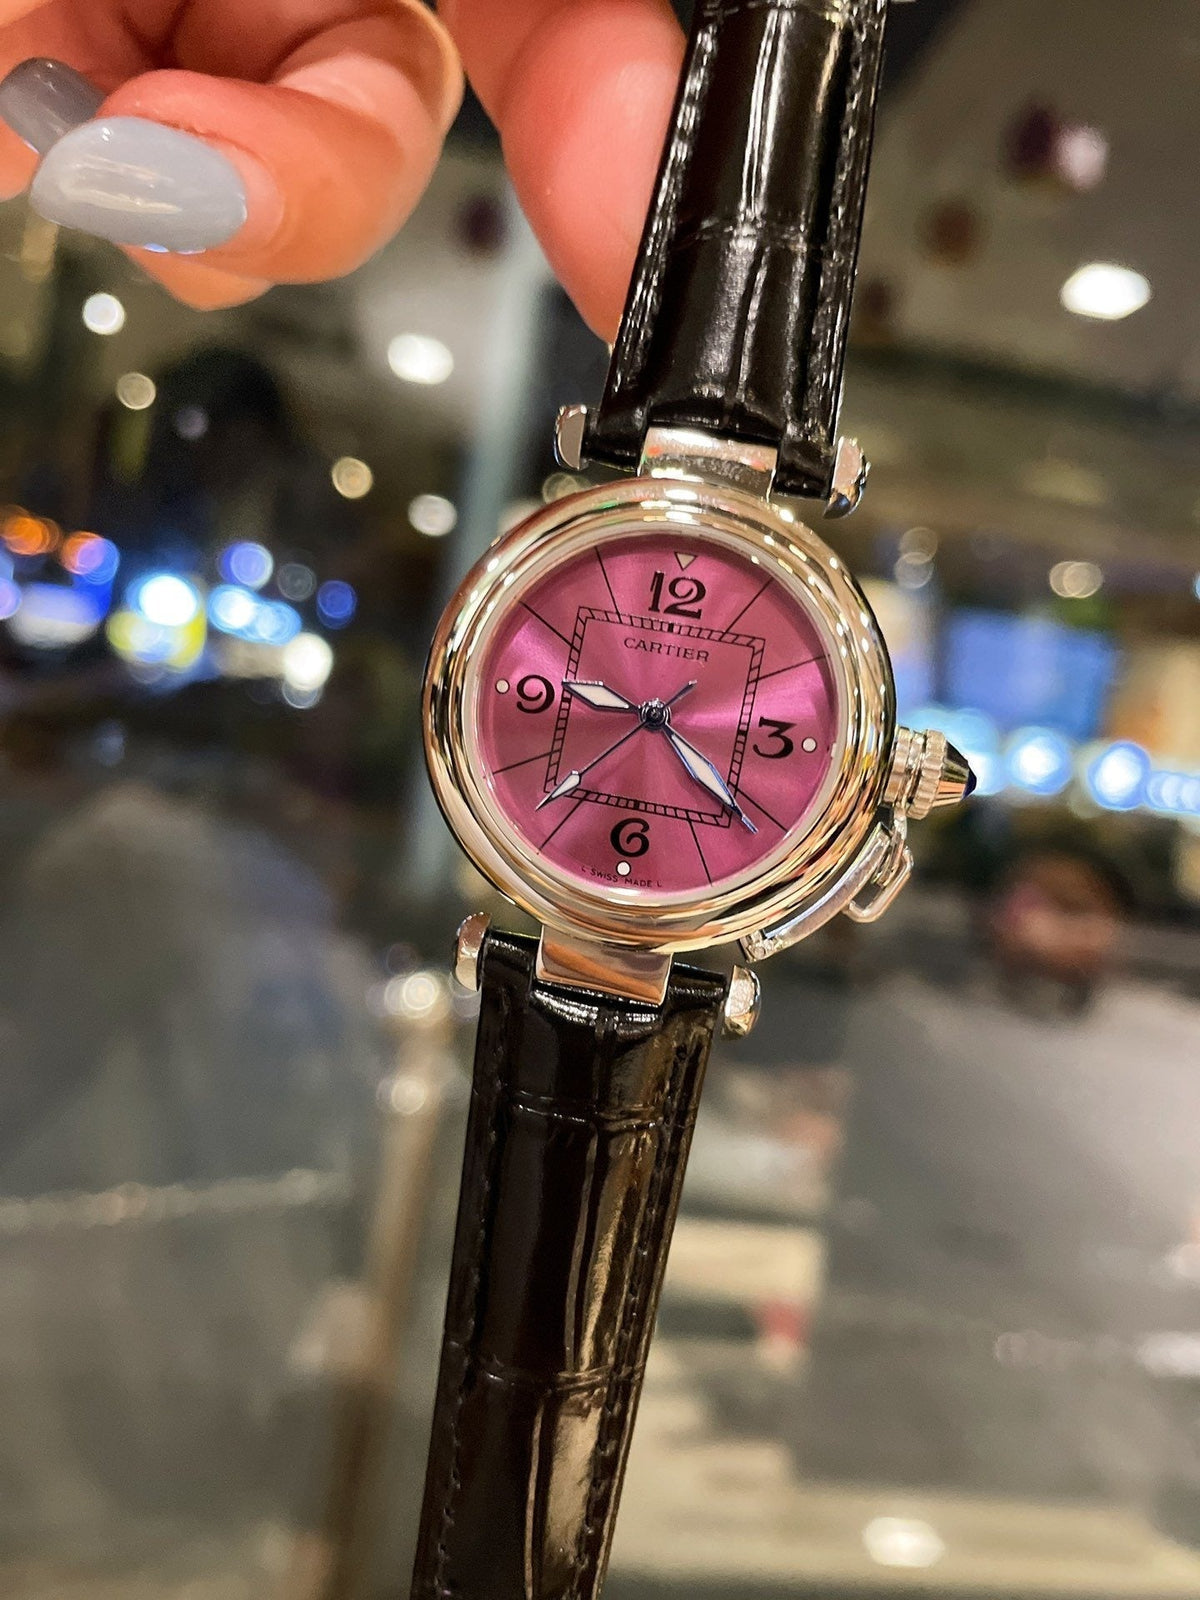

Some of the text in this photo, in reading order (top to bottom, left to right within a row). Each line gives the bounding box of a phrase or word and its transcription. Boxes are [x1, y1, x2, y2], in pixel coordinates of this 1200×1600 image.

[648, 571, 706, 619] 12
[624, 637, 709, 662] CARTIER
[516, 675, 555, 714] 9
[753, 716, 794, 760] 3
[610, 817, 650, 858] 6
[590, 868, 618, 883] SWISS
[624, 878, 653, 888] MADE
